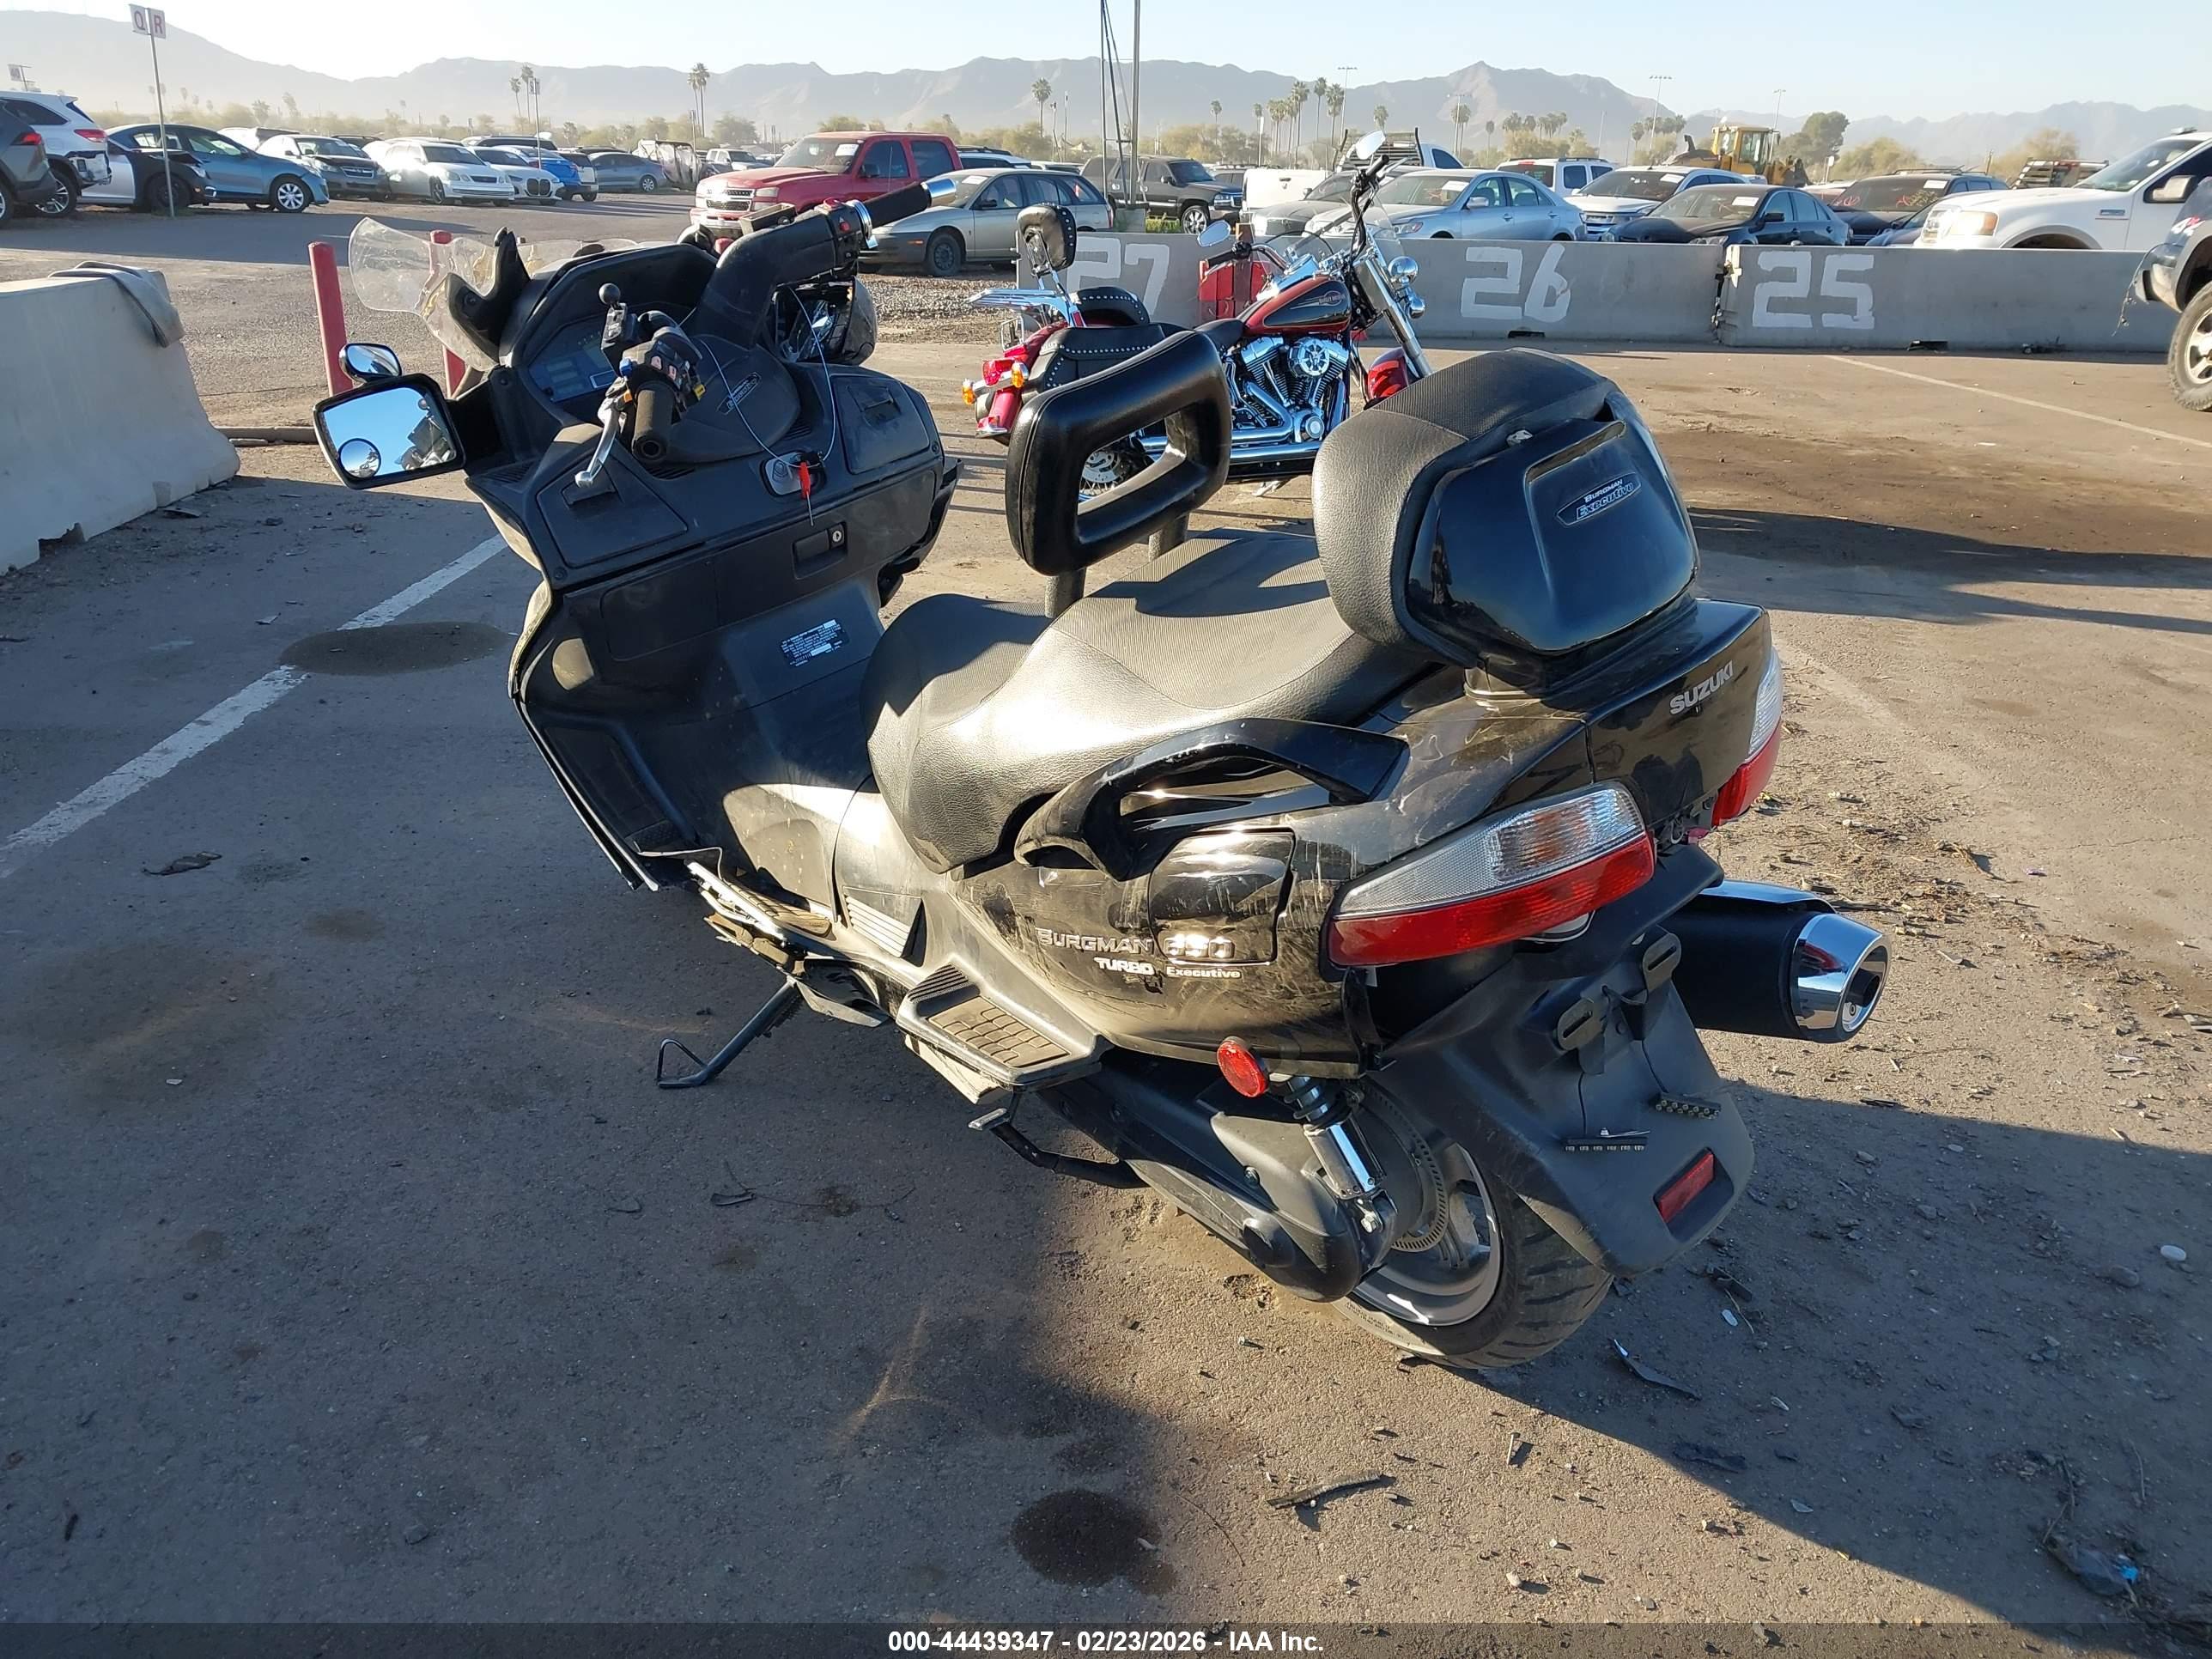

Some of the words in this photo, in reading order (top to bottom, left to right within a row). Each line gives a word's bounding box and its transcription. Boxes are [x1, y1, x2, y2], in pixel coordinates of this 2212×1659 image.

[134, 10, 146, 31] Q
[154, 14, 163, 34] R
[1066, 236, 1170, 316] 27
[1461, 242, 1571, 323] 26
[1753, 251, 1875, 330] 25
[1577, 483, 1634, 520] Executive
[1583, 479, 1623, 503] BURGMAN
[1669, 659, 1733, 714] SUZUKI
[1033, 927, 1153, 955] BURGMAN
[1093, 957, 1156, 975] TURBO
[1166, 966, 1241, 978] Executive
